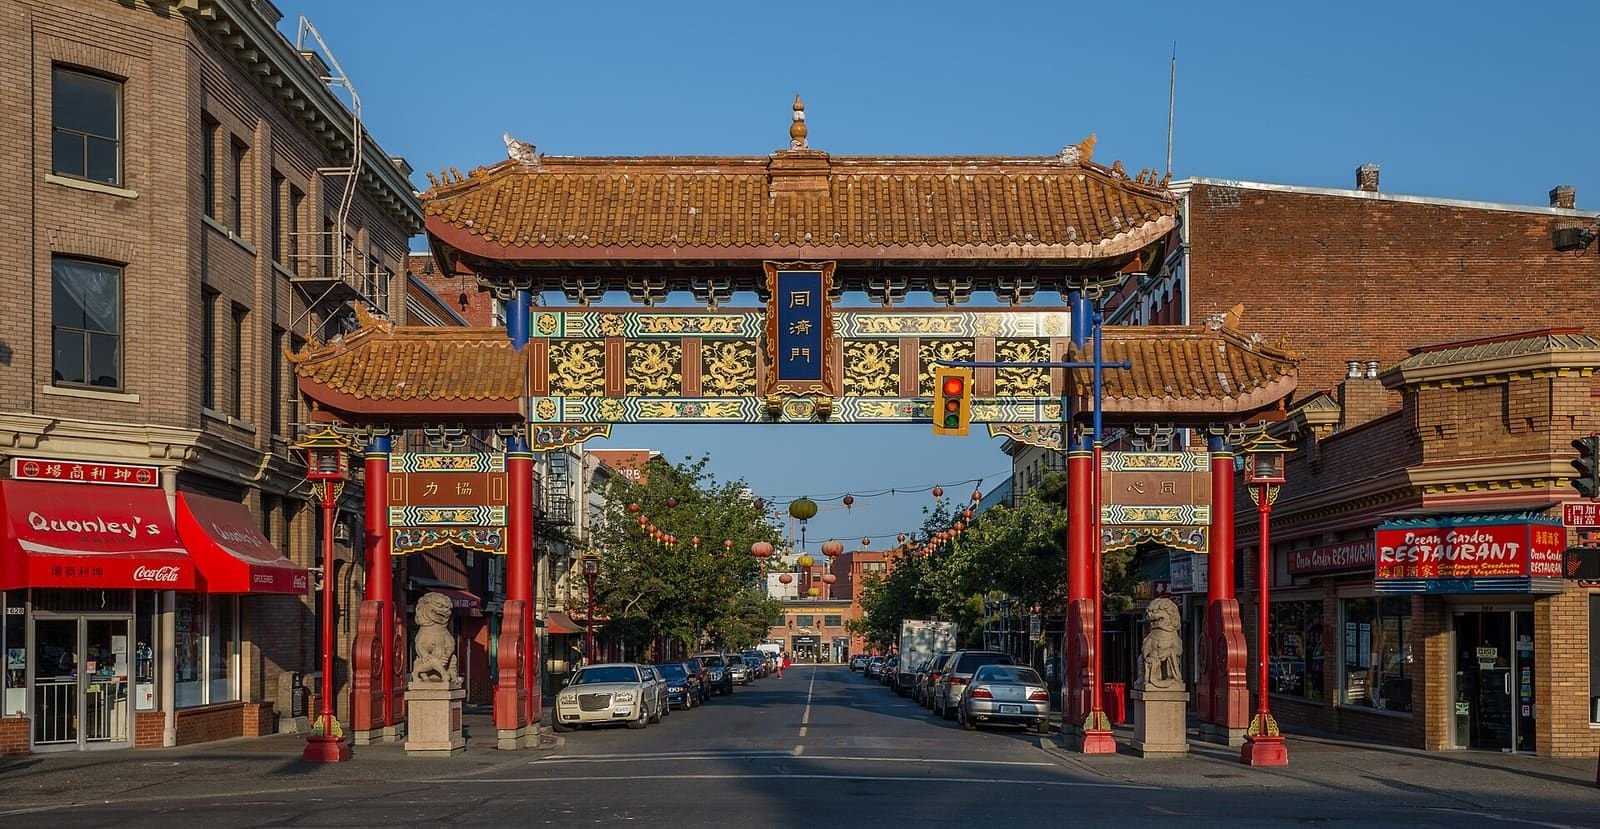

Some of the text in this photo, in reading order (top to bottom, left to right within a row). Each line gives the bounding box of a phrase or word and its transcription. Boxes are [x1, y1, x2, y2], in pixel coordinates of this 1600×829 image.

[789, 290, 813, 364] 同濟門
[1405, 530, 1494, 545] Ocean Garden
[1332, 543, 1376, 567] RESTAURAN
[1380, 542, 1520, 563] RESTAURANT
[1546, 549, 1562, 561] Garde
[1473, 568, 1520, 576] Vegetarian
[1531, 562, 1562, 573] RESTAURAN
